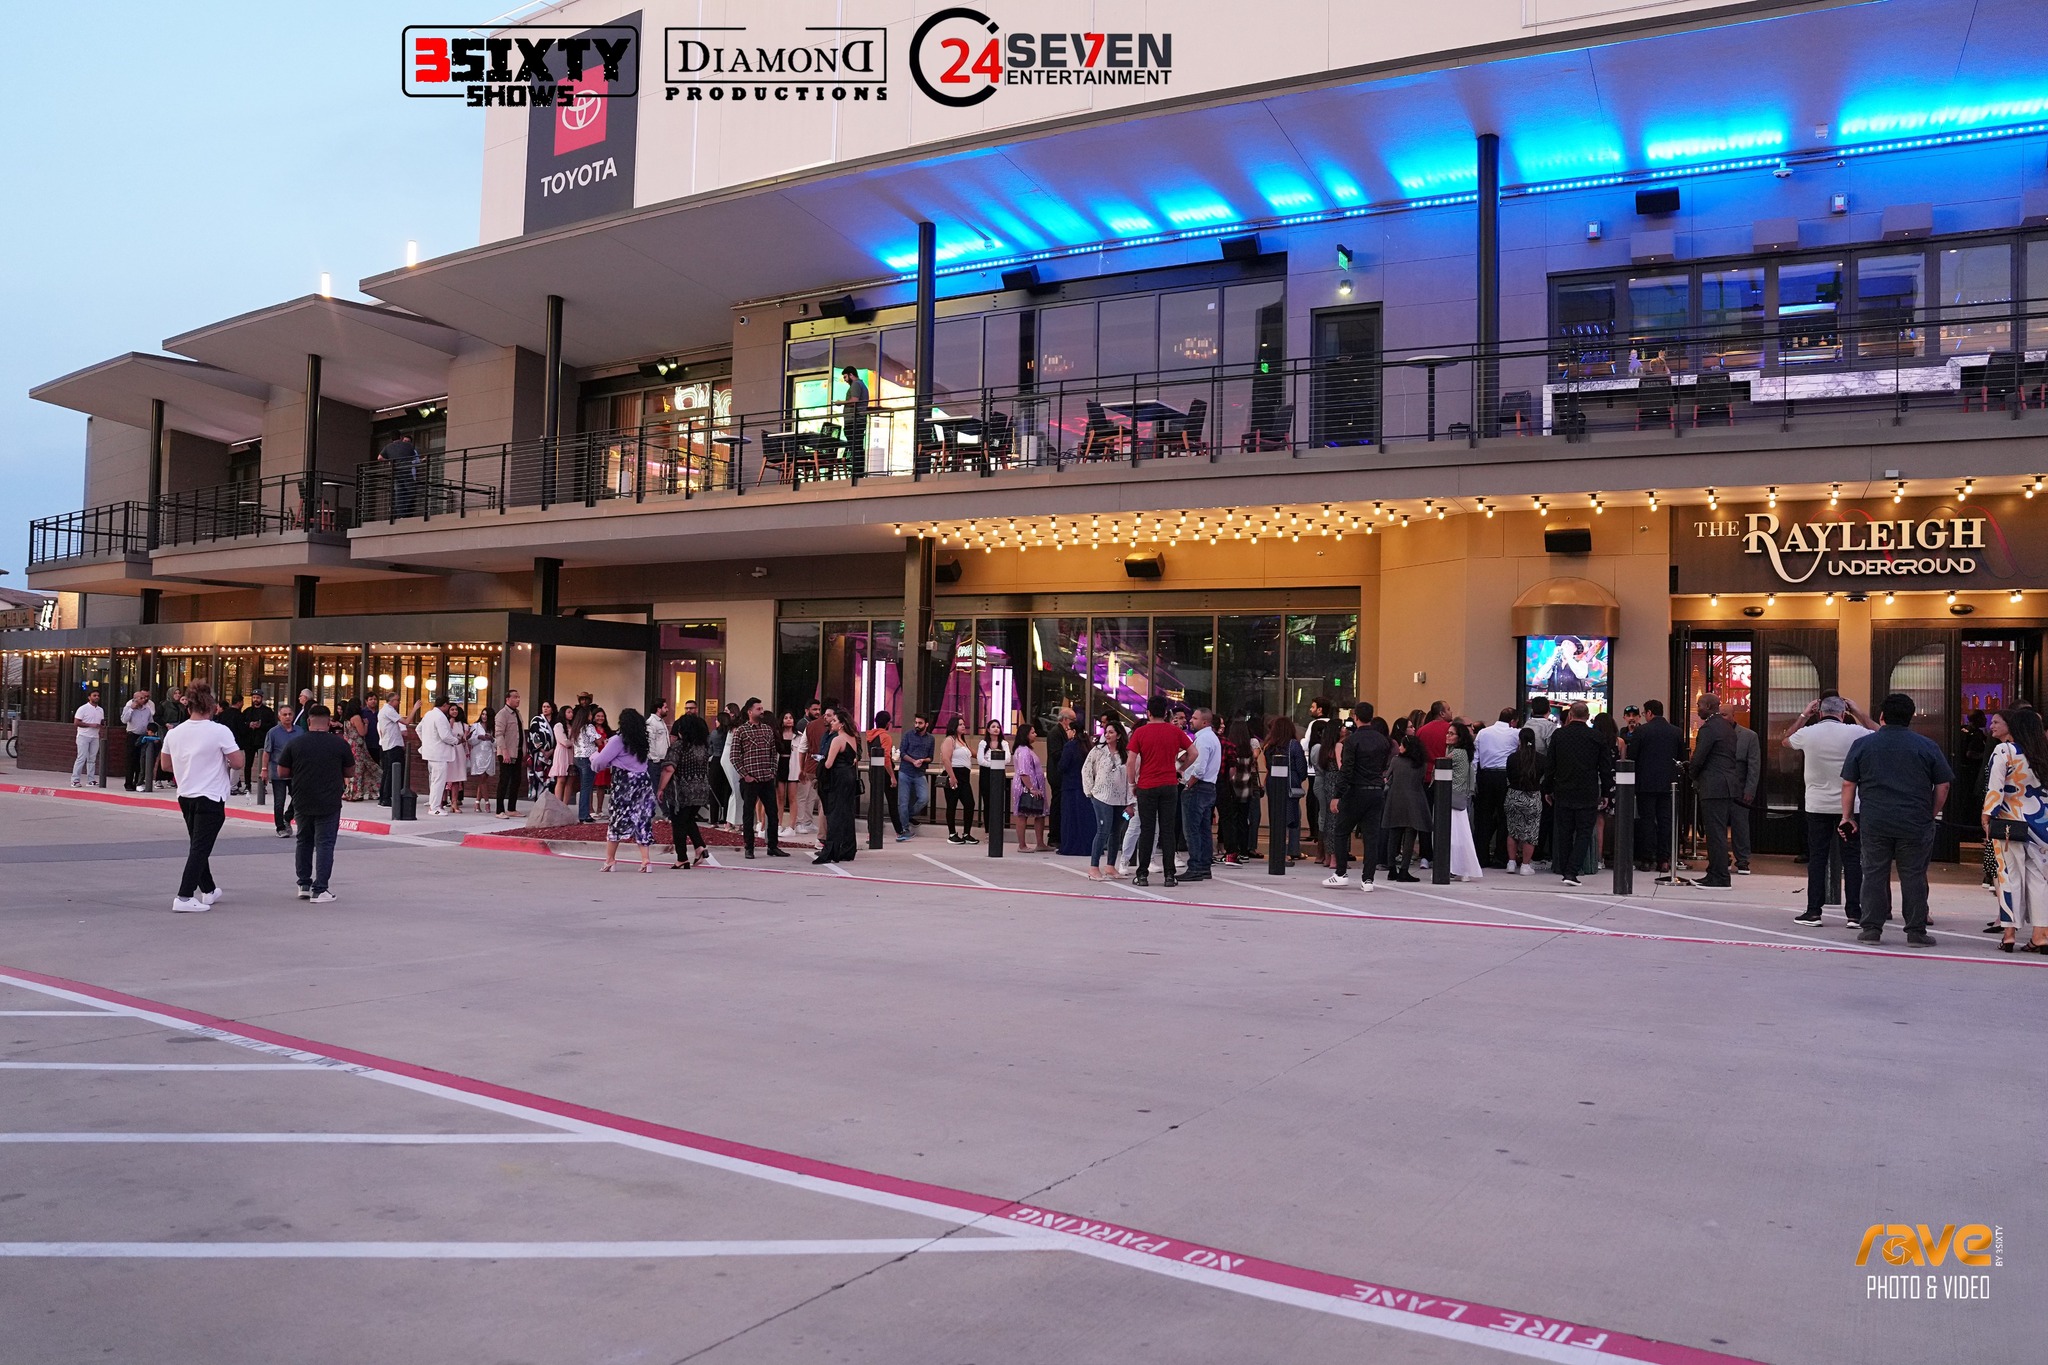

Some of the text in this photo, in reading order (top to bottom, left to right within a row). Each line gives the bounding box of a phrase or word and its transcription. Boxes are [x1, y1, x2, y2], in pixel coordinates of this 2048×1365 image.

[540, 156, 618, 197] TOYOTA
[1693, 513, 1986, 583] THE RAYLEIGH
[1827, 557, 1976, 576] UNDERGROUND
[1008, 1207, 1245, 1271] NO PARKING
[1340, 1283, 1609, 1350] FIRE LANE
